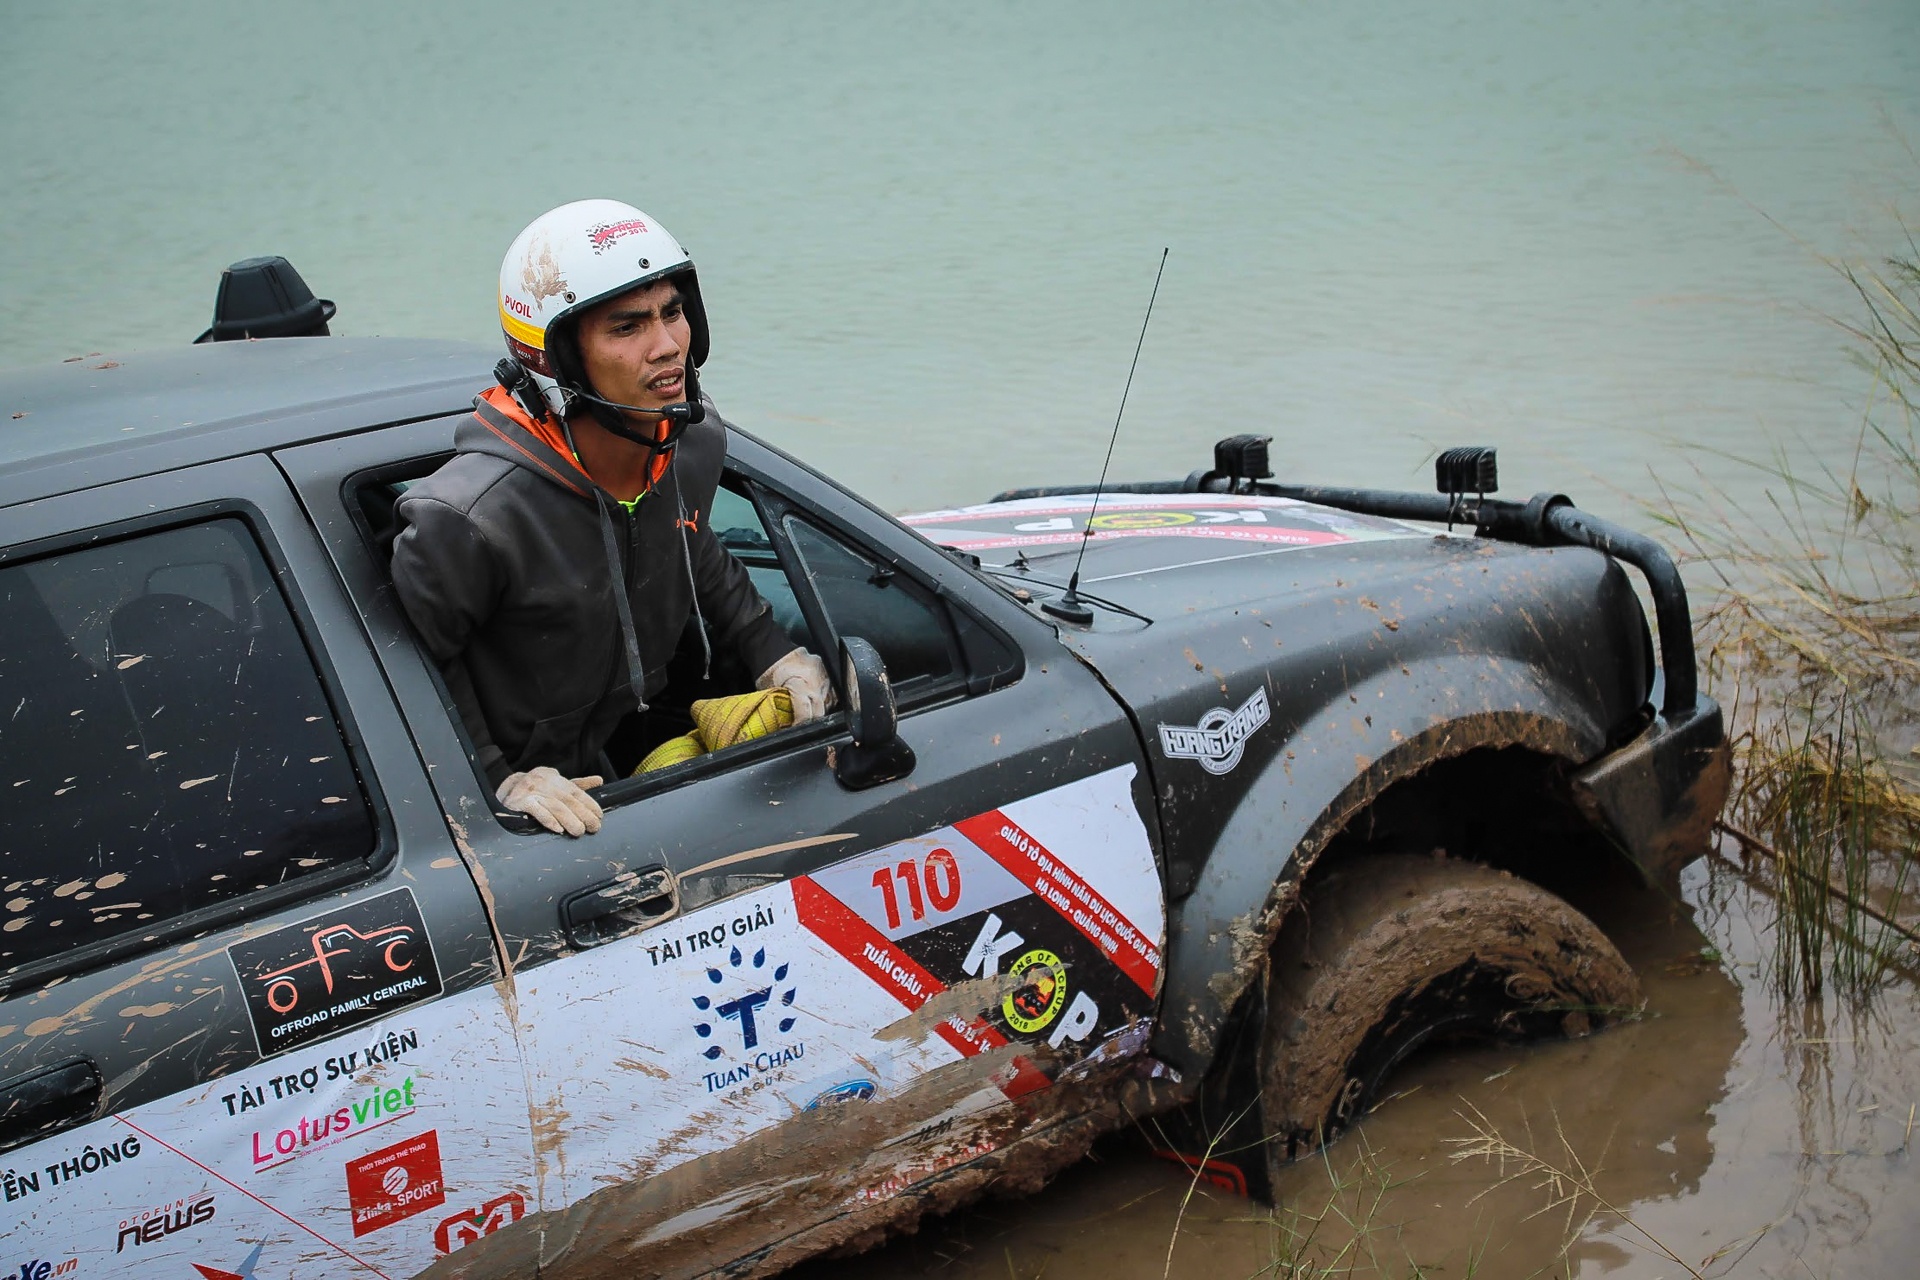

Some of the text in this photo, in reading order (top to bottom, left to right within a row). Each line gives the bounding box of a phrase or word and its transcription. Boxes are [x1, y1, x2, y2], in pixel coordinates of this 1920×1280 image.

[505, 294, 532, 319] PVOIL
[872, 848, 961, 929] 110
[1000, 825, 1022, 847] GIẢI
[1019, 837, 1029, 852] Ô
[1026, 845, 1040, 861] TÔ
[1037, 854, 1053, 874] ĐỊA
[1051, 866, 1074, 890] HÌNH
[1071, 883, 1092, 905] NĂM
[1100, 907, 1118, 928] LỊCH
[1115, 921, 1136, 945] QUỐC
[1132, 938, 1147, 956] GIA
[1035, 877, 1049, 896] HẠ
[1047, 887, 1070, 911] LONG
[1073, 910, 1101, 938] QUẢNG
[1099, 931, 1119, 954] NINH
[646, 904, 775, 966] TÀI TRỢ GIẢI
[1038, 953, 1051, 962] OF
[271, 976, 428, 1038] OFFROAD FAMILY CENTRAL
[890, 962, 923, 996] CHÂU
[1009, 1013, 1029, 1029] 2018
[222, 1030, 419, 1117] TÀI TRỢ SỰ KIỆN
[702, 1063, 750, 1093] TUAN
[252, 1076, 415, 1166] Lotusviet
[0, 1137, 141, 1202] ỀN THÔNG
[374, 1154, 396, 1168] TRANG
[409, 1142, 427, 1154] THAO
[119, 1199, 184, 1229] OTOFUN
